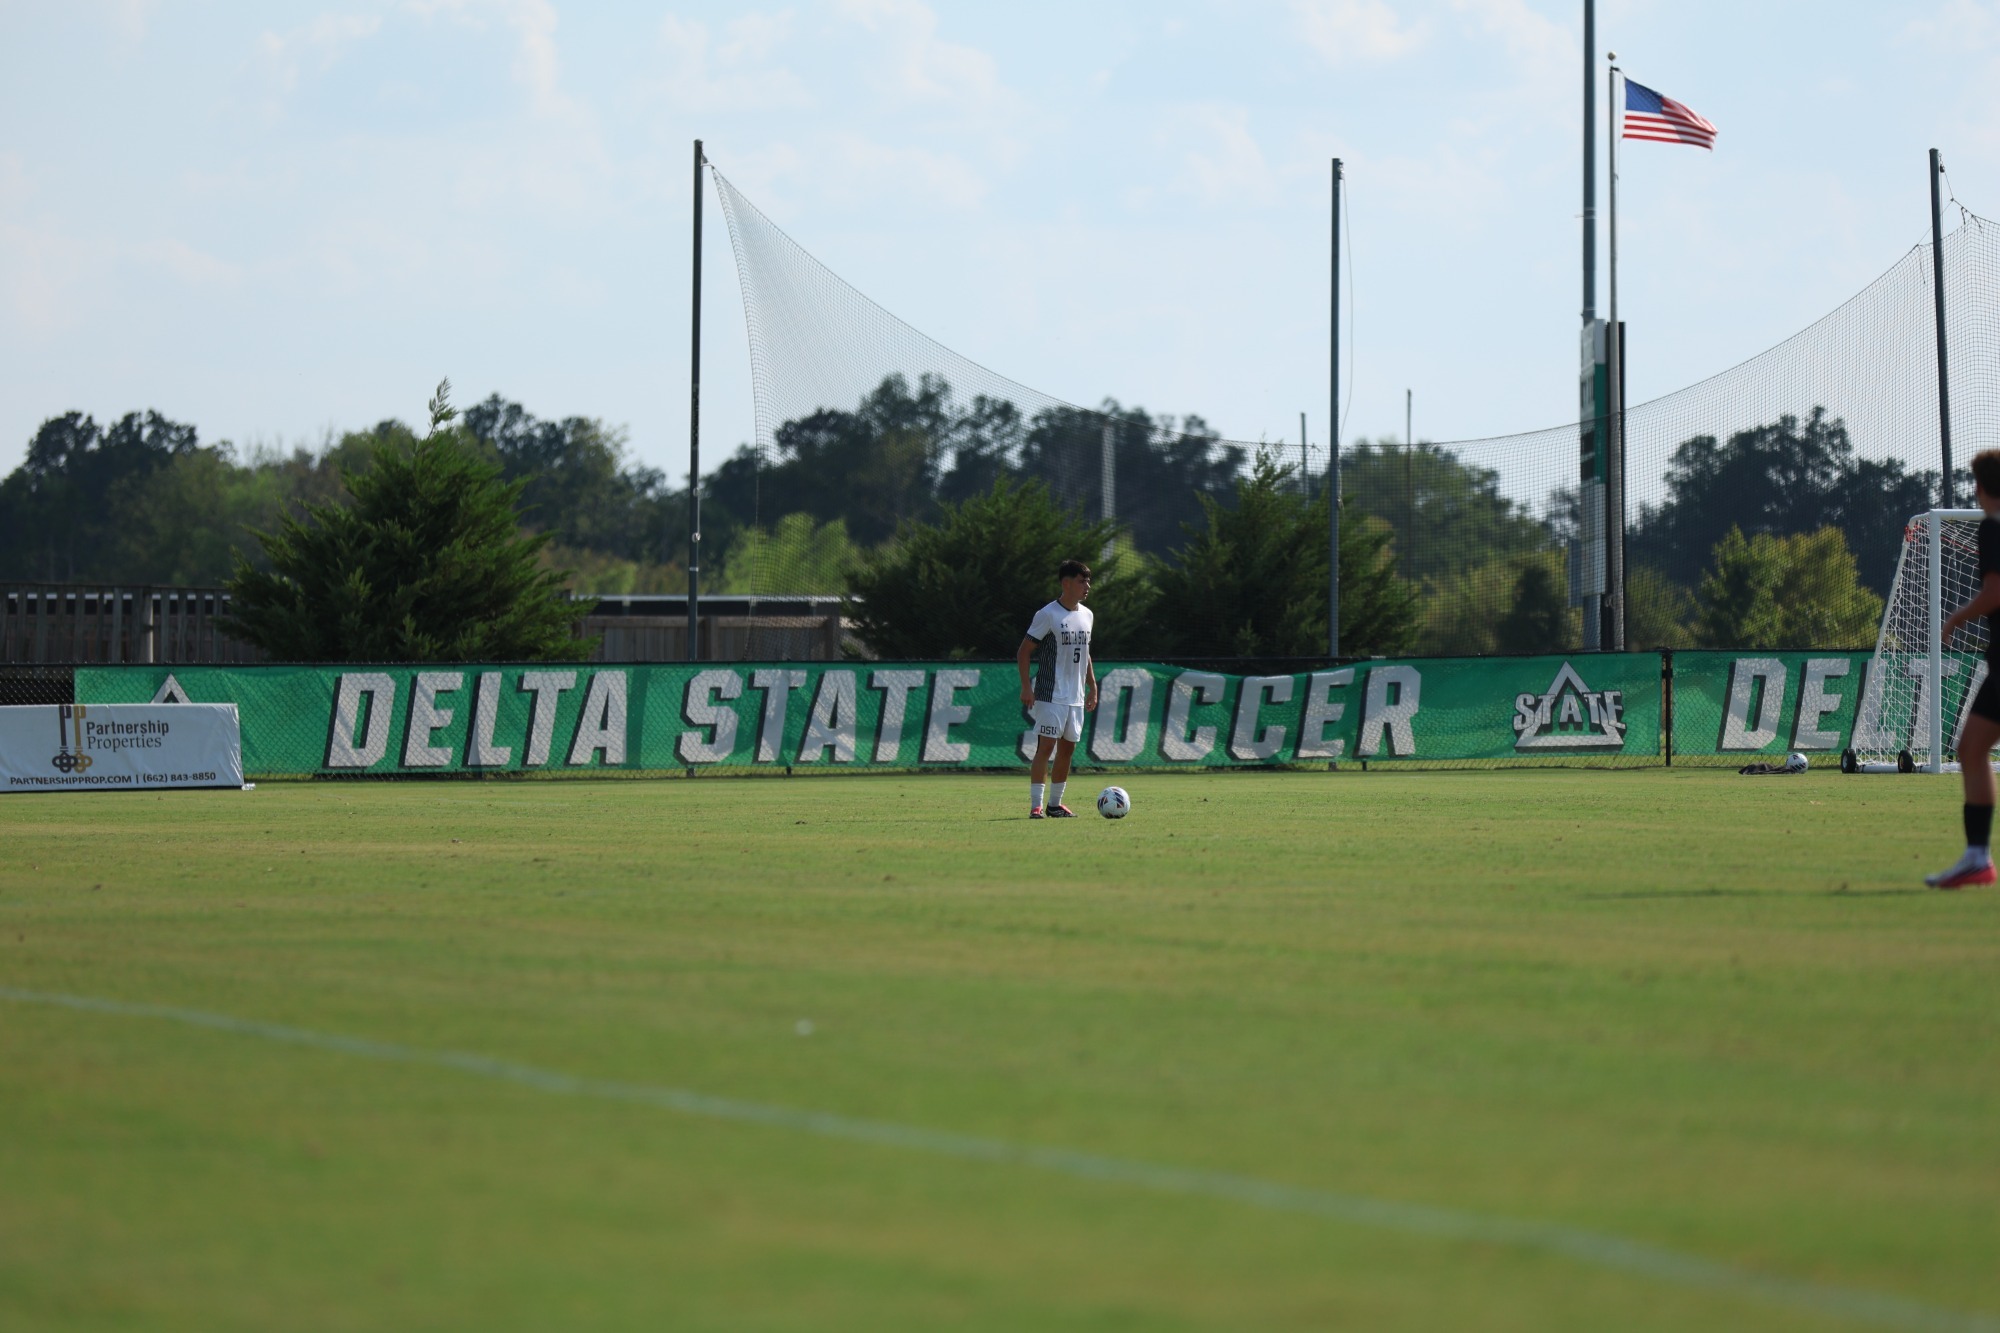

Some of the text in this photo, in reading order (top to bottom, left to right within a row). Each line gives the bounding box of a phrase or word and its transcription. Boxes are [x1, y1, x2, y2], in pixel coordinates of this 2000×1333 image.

[1061, 630, 1091, 645] DELTA STAT
[1073, 648, 1081, 663] 5
[324, 671, 628, 768] DELTA
[674, 669, 981, 764] STATE
[1513, 690, 1627, 734] STATE
[86, 720, 169, 736] Partnership
[1040, 725, 1058, 735] DSU
[87, 735, 162, 752] Properties
[10, 775, 132, 785] PARTNERSHIPPROP.COM
[142, 773, 168, 783] (662)
[170, 771, 216, 782] 843-8850
